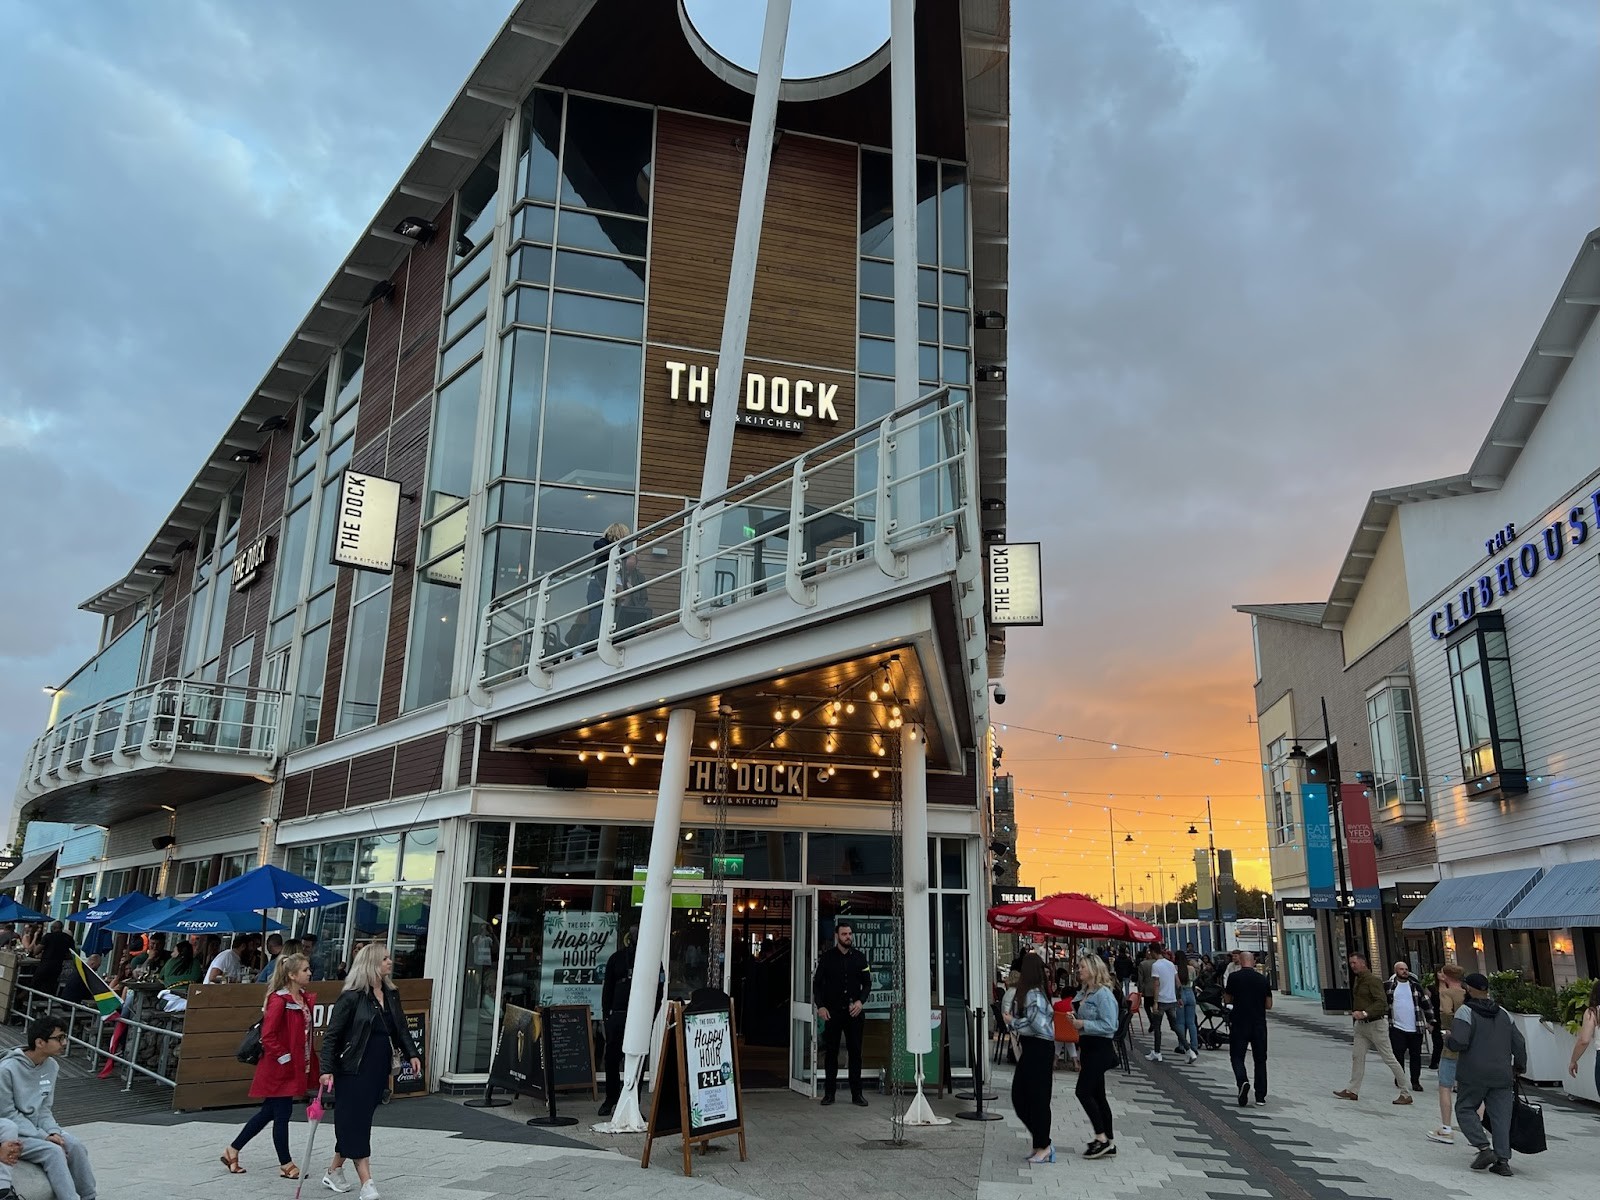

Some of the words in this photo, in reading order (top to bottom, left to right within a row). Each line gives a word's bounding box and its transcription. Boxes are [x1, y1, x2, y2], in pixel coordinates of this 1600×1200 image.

[666, 361, 719, 403] TH
[746, 373, 838, 421] DOCK
[745, 415, 801, 430] KITCHEN
[345, 475, 366, 518] DOCK
[340, 521, 361, 550] THE
[1485, 523, 1516, 557] THE
[359, 557, 389, 567] KITCHEN
[993, 548, 1009, 583] DOCK
[994, 588, 1010, 613] THE
[737, 763, 802, 794] DOCK
[736, 798, 777, 806] KITCHEN
[1307, 824, 1329, 835] EAT
[1349, 829, 1371, 837] YFED
[281, 890, 320, 900] PERONI
[1001, 893, 1014, 901] THE
[1014, 893, 1032, 902] DOCK
[579, 921, 595, 929] DOCK
[857, 922, 866, 930] THE
[867, 922, 880, 930] DOCK
[552, 929, 610, 953] Happy
[562, 950, 597, 967] HOUR
[562, 969, 595, 984] 2-4-1
[694, 1029, 724, 1050] Happy
[700, 1047, 721, 1068] HOUR
[702, 1070, 722, 1087] 2-4-1
